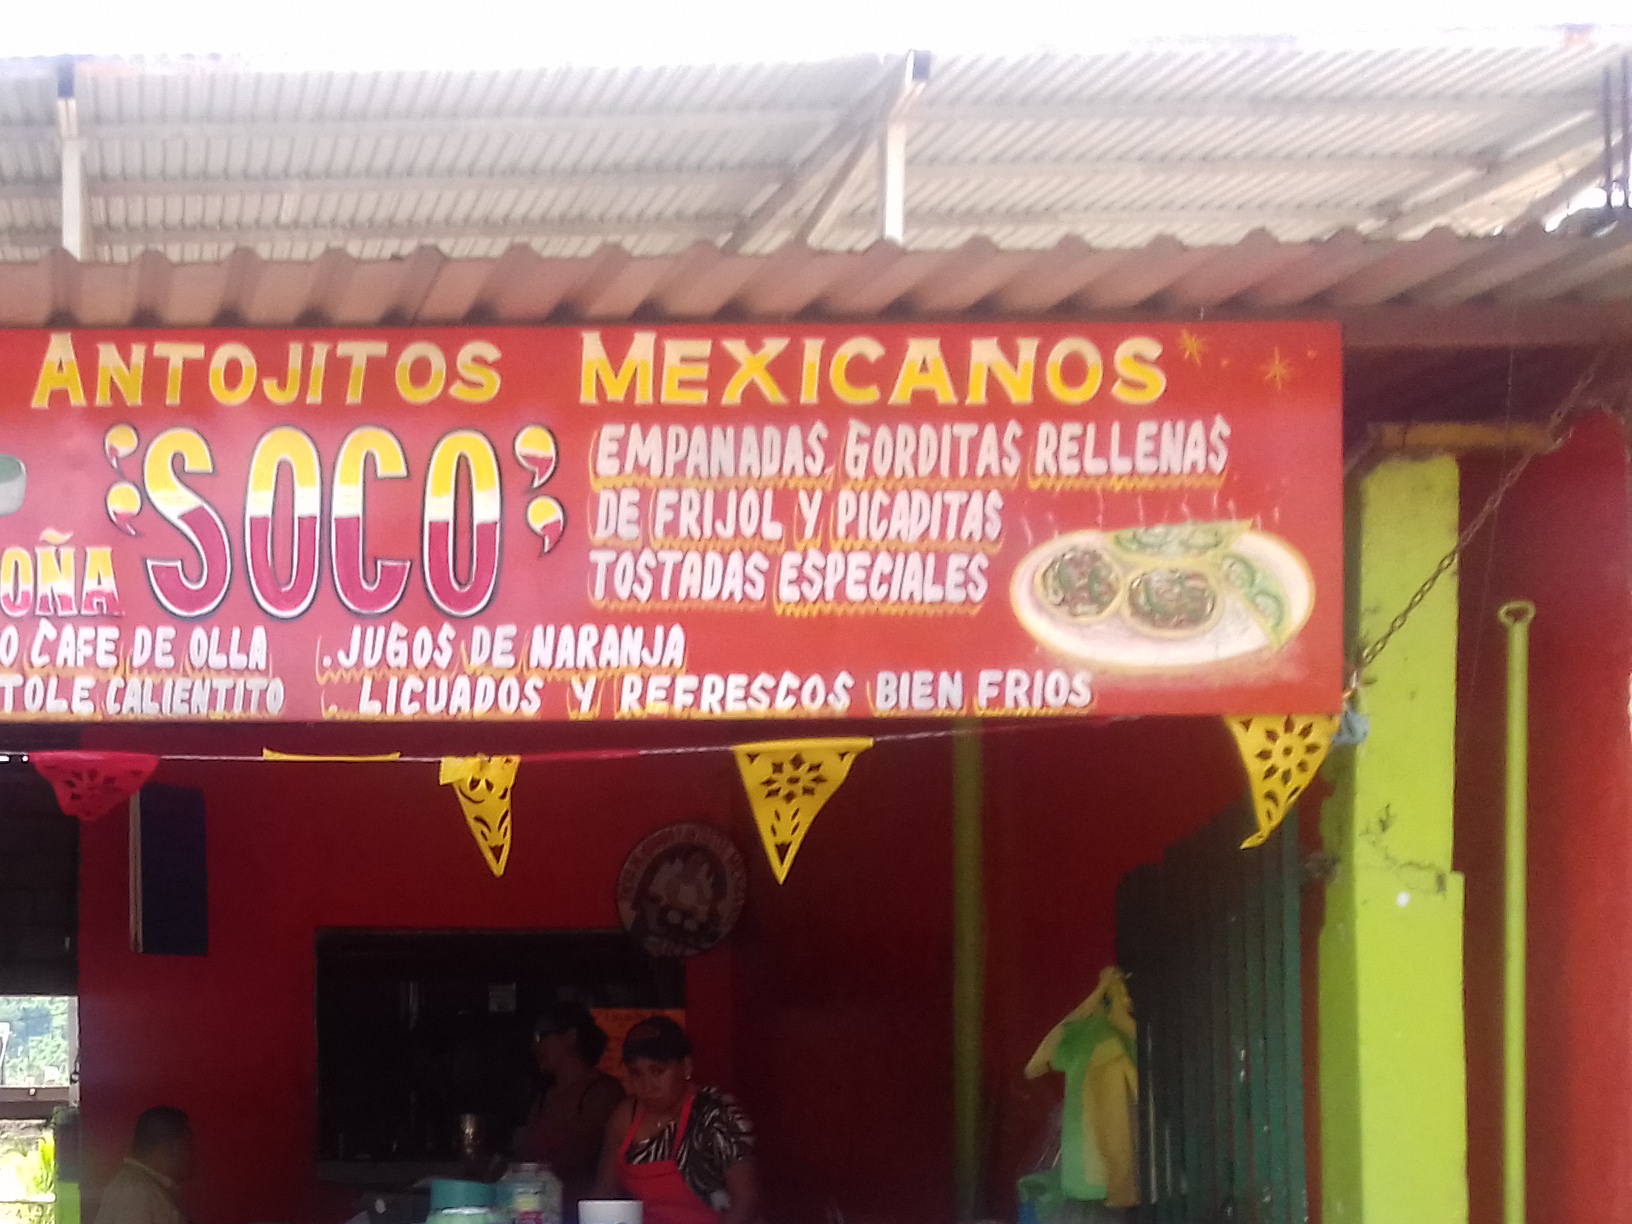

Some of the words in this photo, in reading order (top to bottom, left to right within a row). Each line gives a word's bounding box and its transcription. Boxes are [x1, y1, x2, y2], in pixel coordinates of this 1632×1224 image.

[30, 331, 503, 408] ANTOJITOS
[579, 331, 1169, 406] MEXICANOS
[845, 418, 1022, 479] GORDITAS
[1035, 413, 1231, 476] RELLENAS
[596, 487, 640, 540] DE
[654, 488, 783, 540] FRIJOL
[798, 488, 822, 539] Y
[837, 487, 1004, 544] PICADITAS
[589, 549, 769, 602] TOSTADAS
[779, 549, 989, 604] ESPECIALES
[30, 617, 120, 669] CAFE
[133, 625, 175, 669] DE
[189, 625, 267, 670] OLLA
[472, 623, 517, 669] DE
[529, 623, 686, 670] NARANJA
[106, 677, 285, 715] CALIENTITO
[570, 676, 597, 715] Y
[620, 670, 855, 715] REFRESCOS
[875, 670, 963, 710] BIEN
[977, 669, 1093, 709] FRIOS
